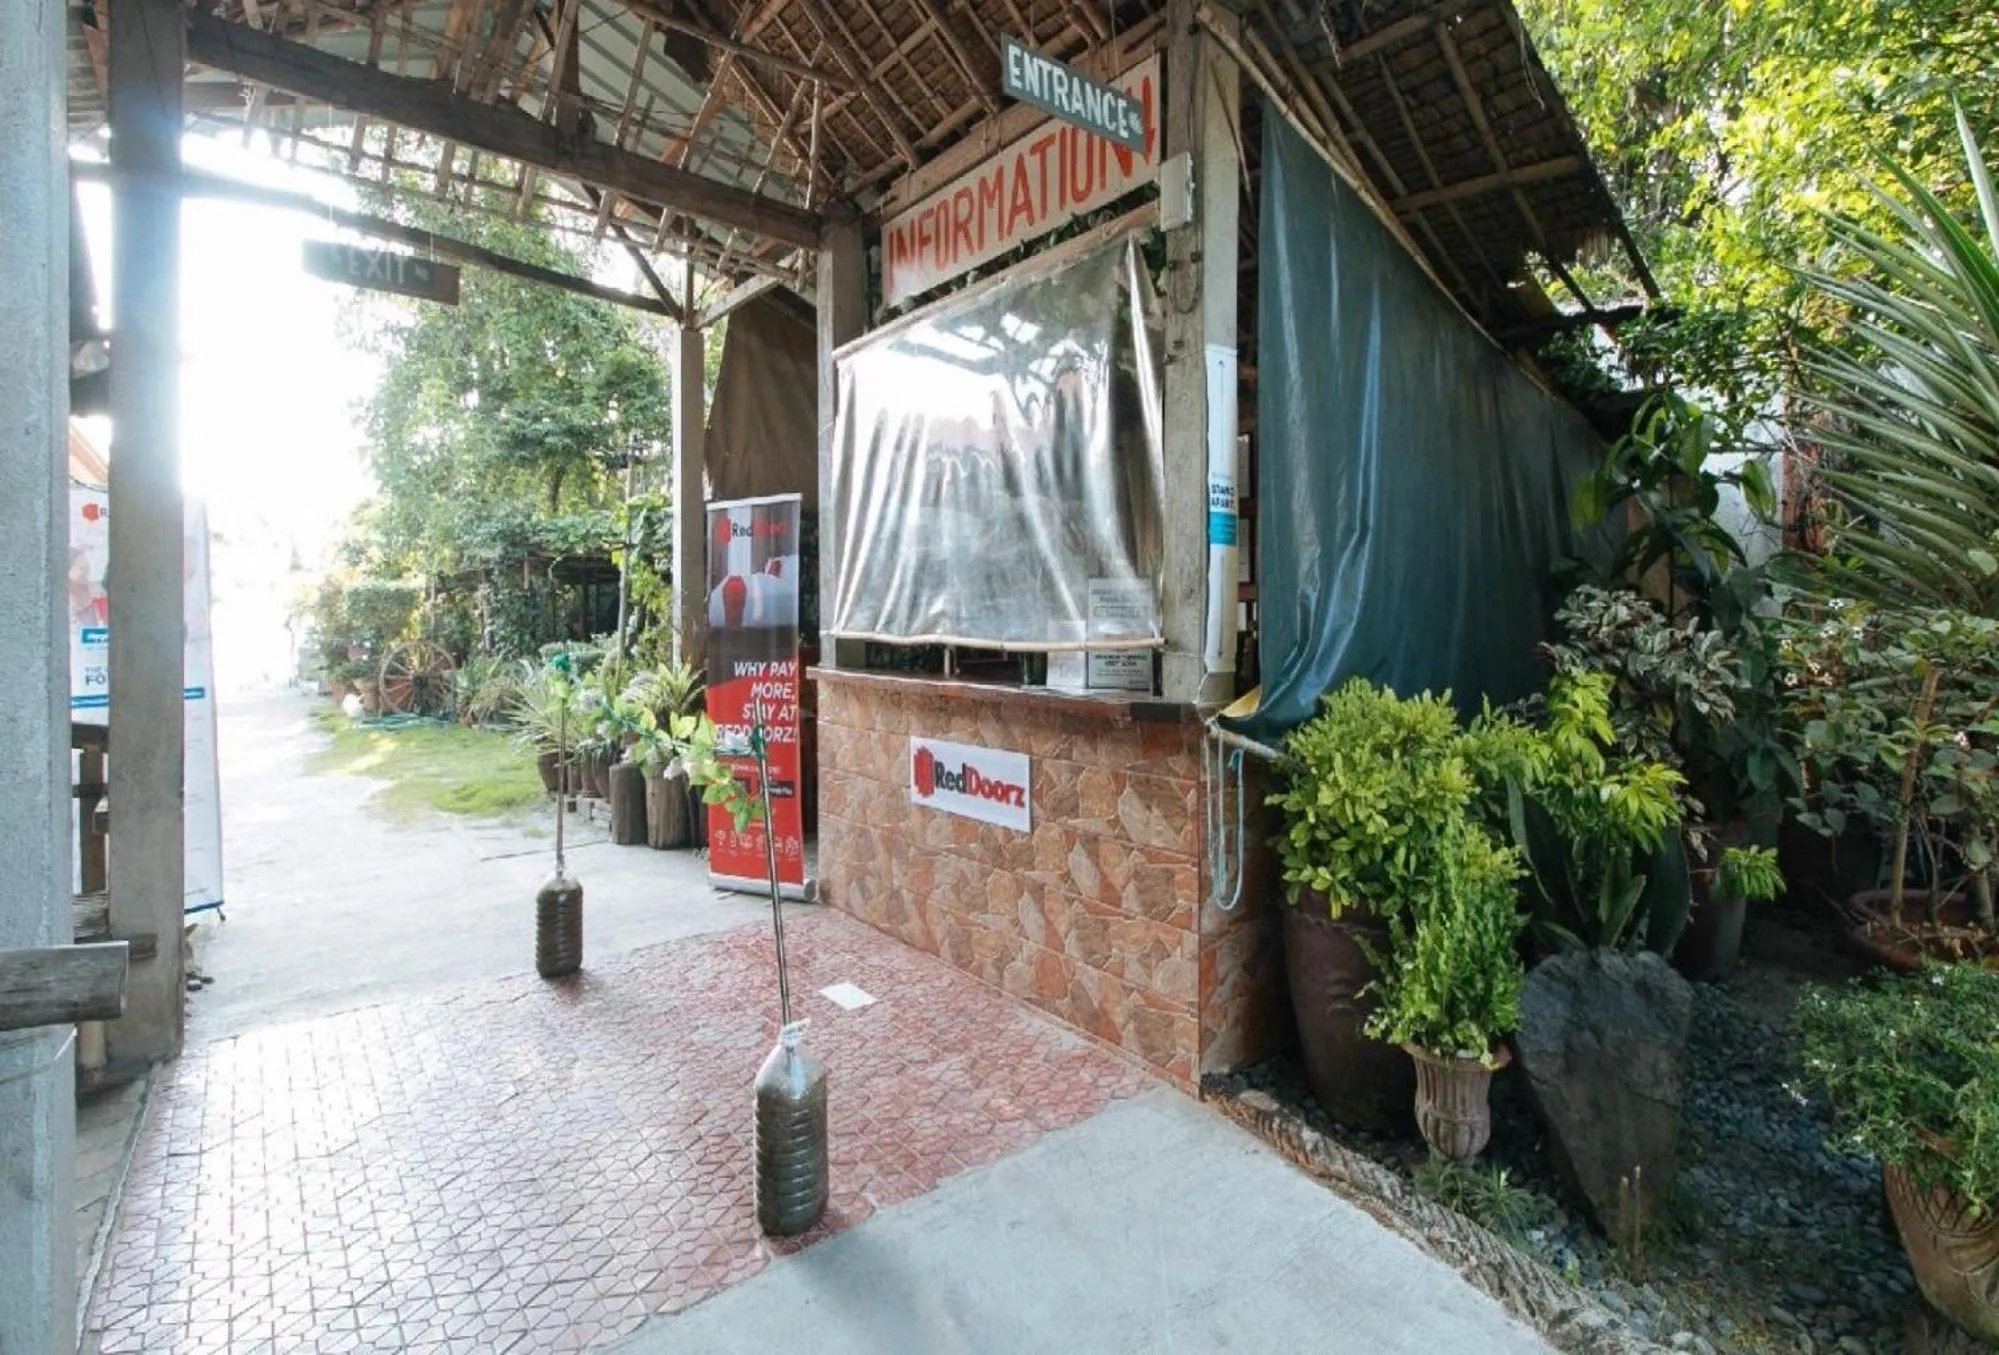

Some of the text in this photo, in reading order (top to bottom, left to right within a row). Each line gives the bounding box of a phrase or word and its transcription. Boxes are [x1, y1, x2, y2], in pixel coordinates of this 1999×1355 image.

[1008, 44, 1129, 138] ENTRANCE
[348, 246, 409, 285] EXIT
[734, 661, 798, 677] WHY PAY
[778, 703, 798, 721] AT
[934, 760, 1025, 808] RedDoorz
